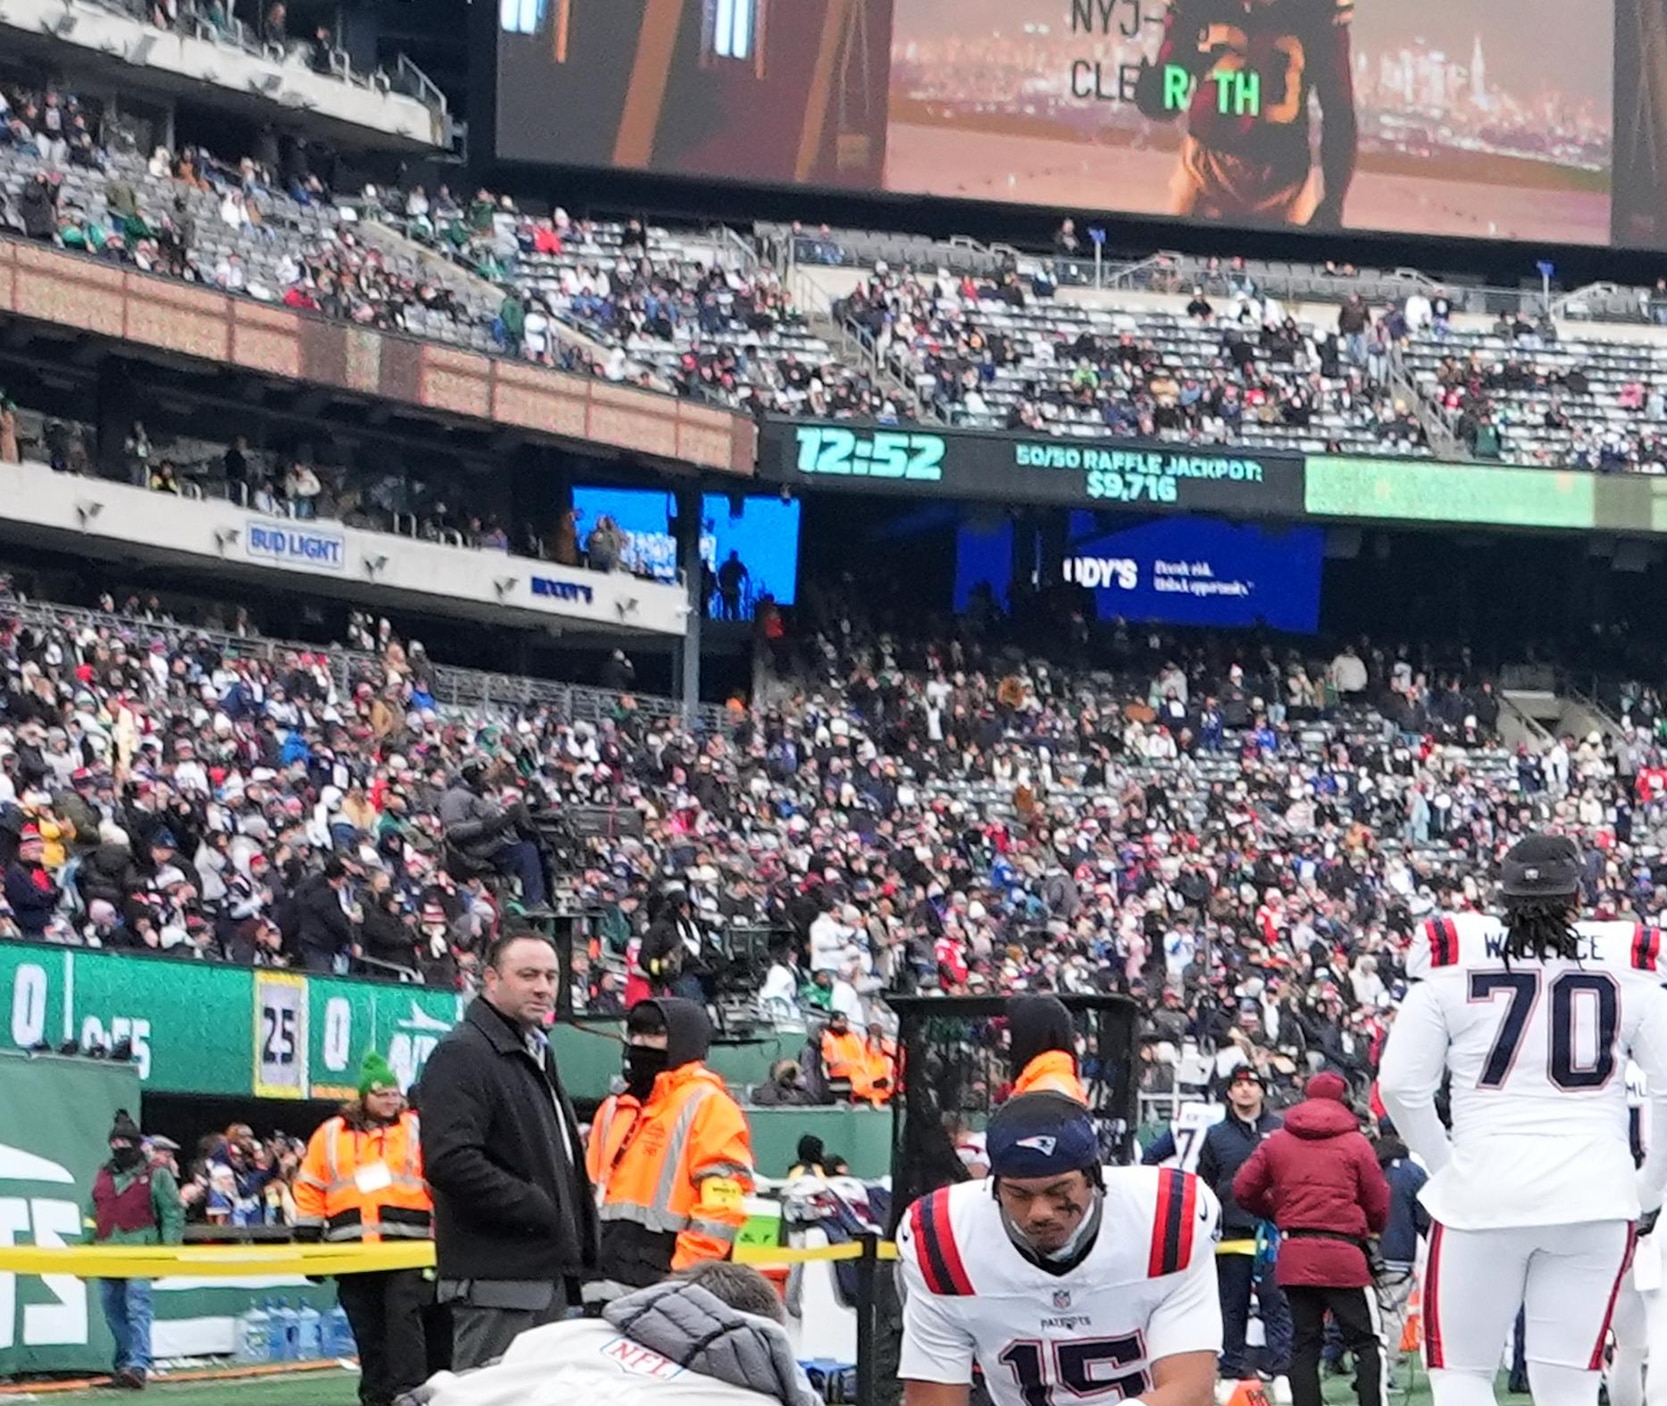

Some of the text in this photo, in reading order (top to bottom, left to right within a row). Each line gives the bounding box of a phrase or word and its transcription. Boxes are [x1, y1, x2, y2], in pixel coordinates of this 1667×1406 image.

[796, 427, 945, 480] 12:52
[1016, 445, 1264, 482] 50/50 RAFFLE JACKPOT:
[1087, 472, 1177, 502] $9,716
[251, 527, 340, 563] BUD LIGHT
[1484, 931, 1604, 961] WACE
[11, 962, 49, 1048] 0
[262, 1006, 295, 1065] 25
[323, 996, 352, 1073] 0
[1467, 967, 1622, 1093] 70
[610, 1342, 669, 1378] NFL
